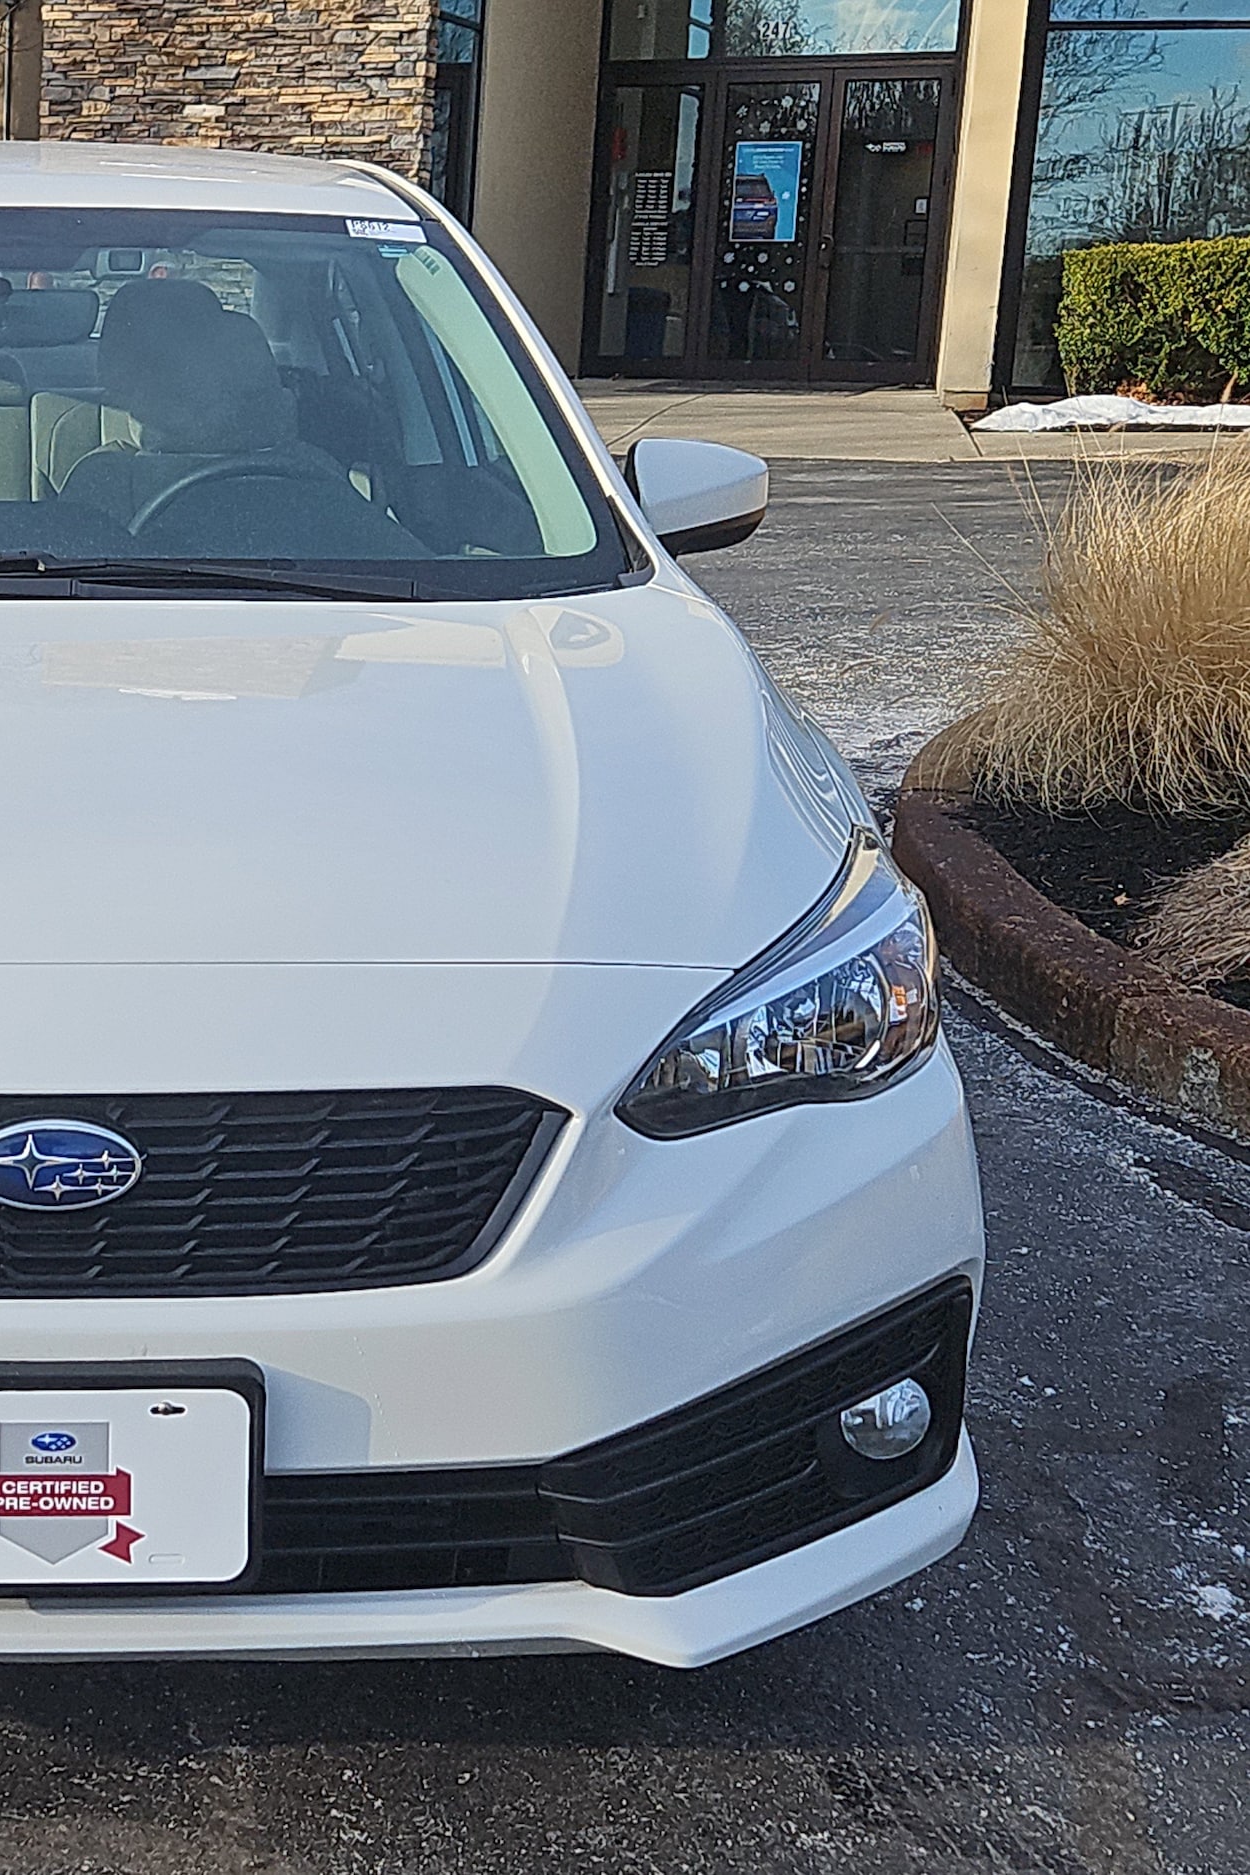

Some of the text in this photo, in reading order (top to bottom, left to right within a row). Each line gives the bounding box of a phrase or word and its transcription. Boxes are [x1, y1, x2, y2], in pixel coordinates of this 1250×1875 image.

[762, 21, 789, 37] 247
[25, 1455, 83, 1464] SUBARU
[1, 1480, 105, 1495] CERTIFIED
